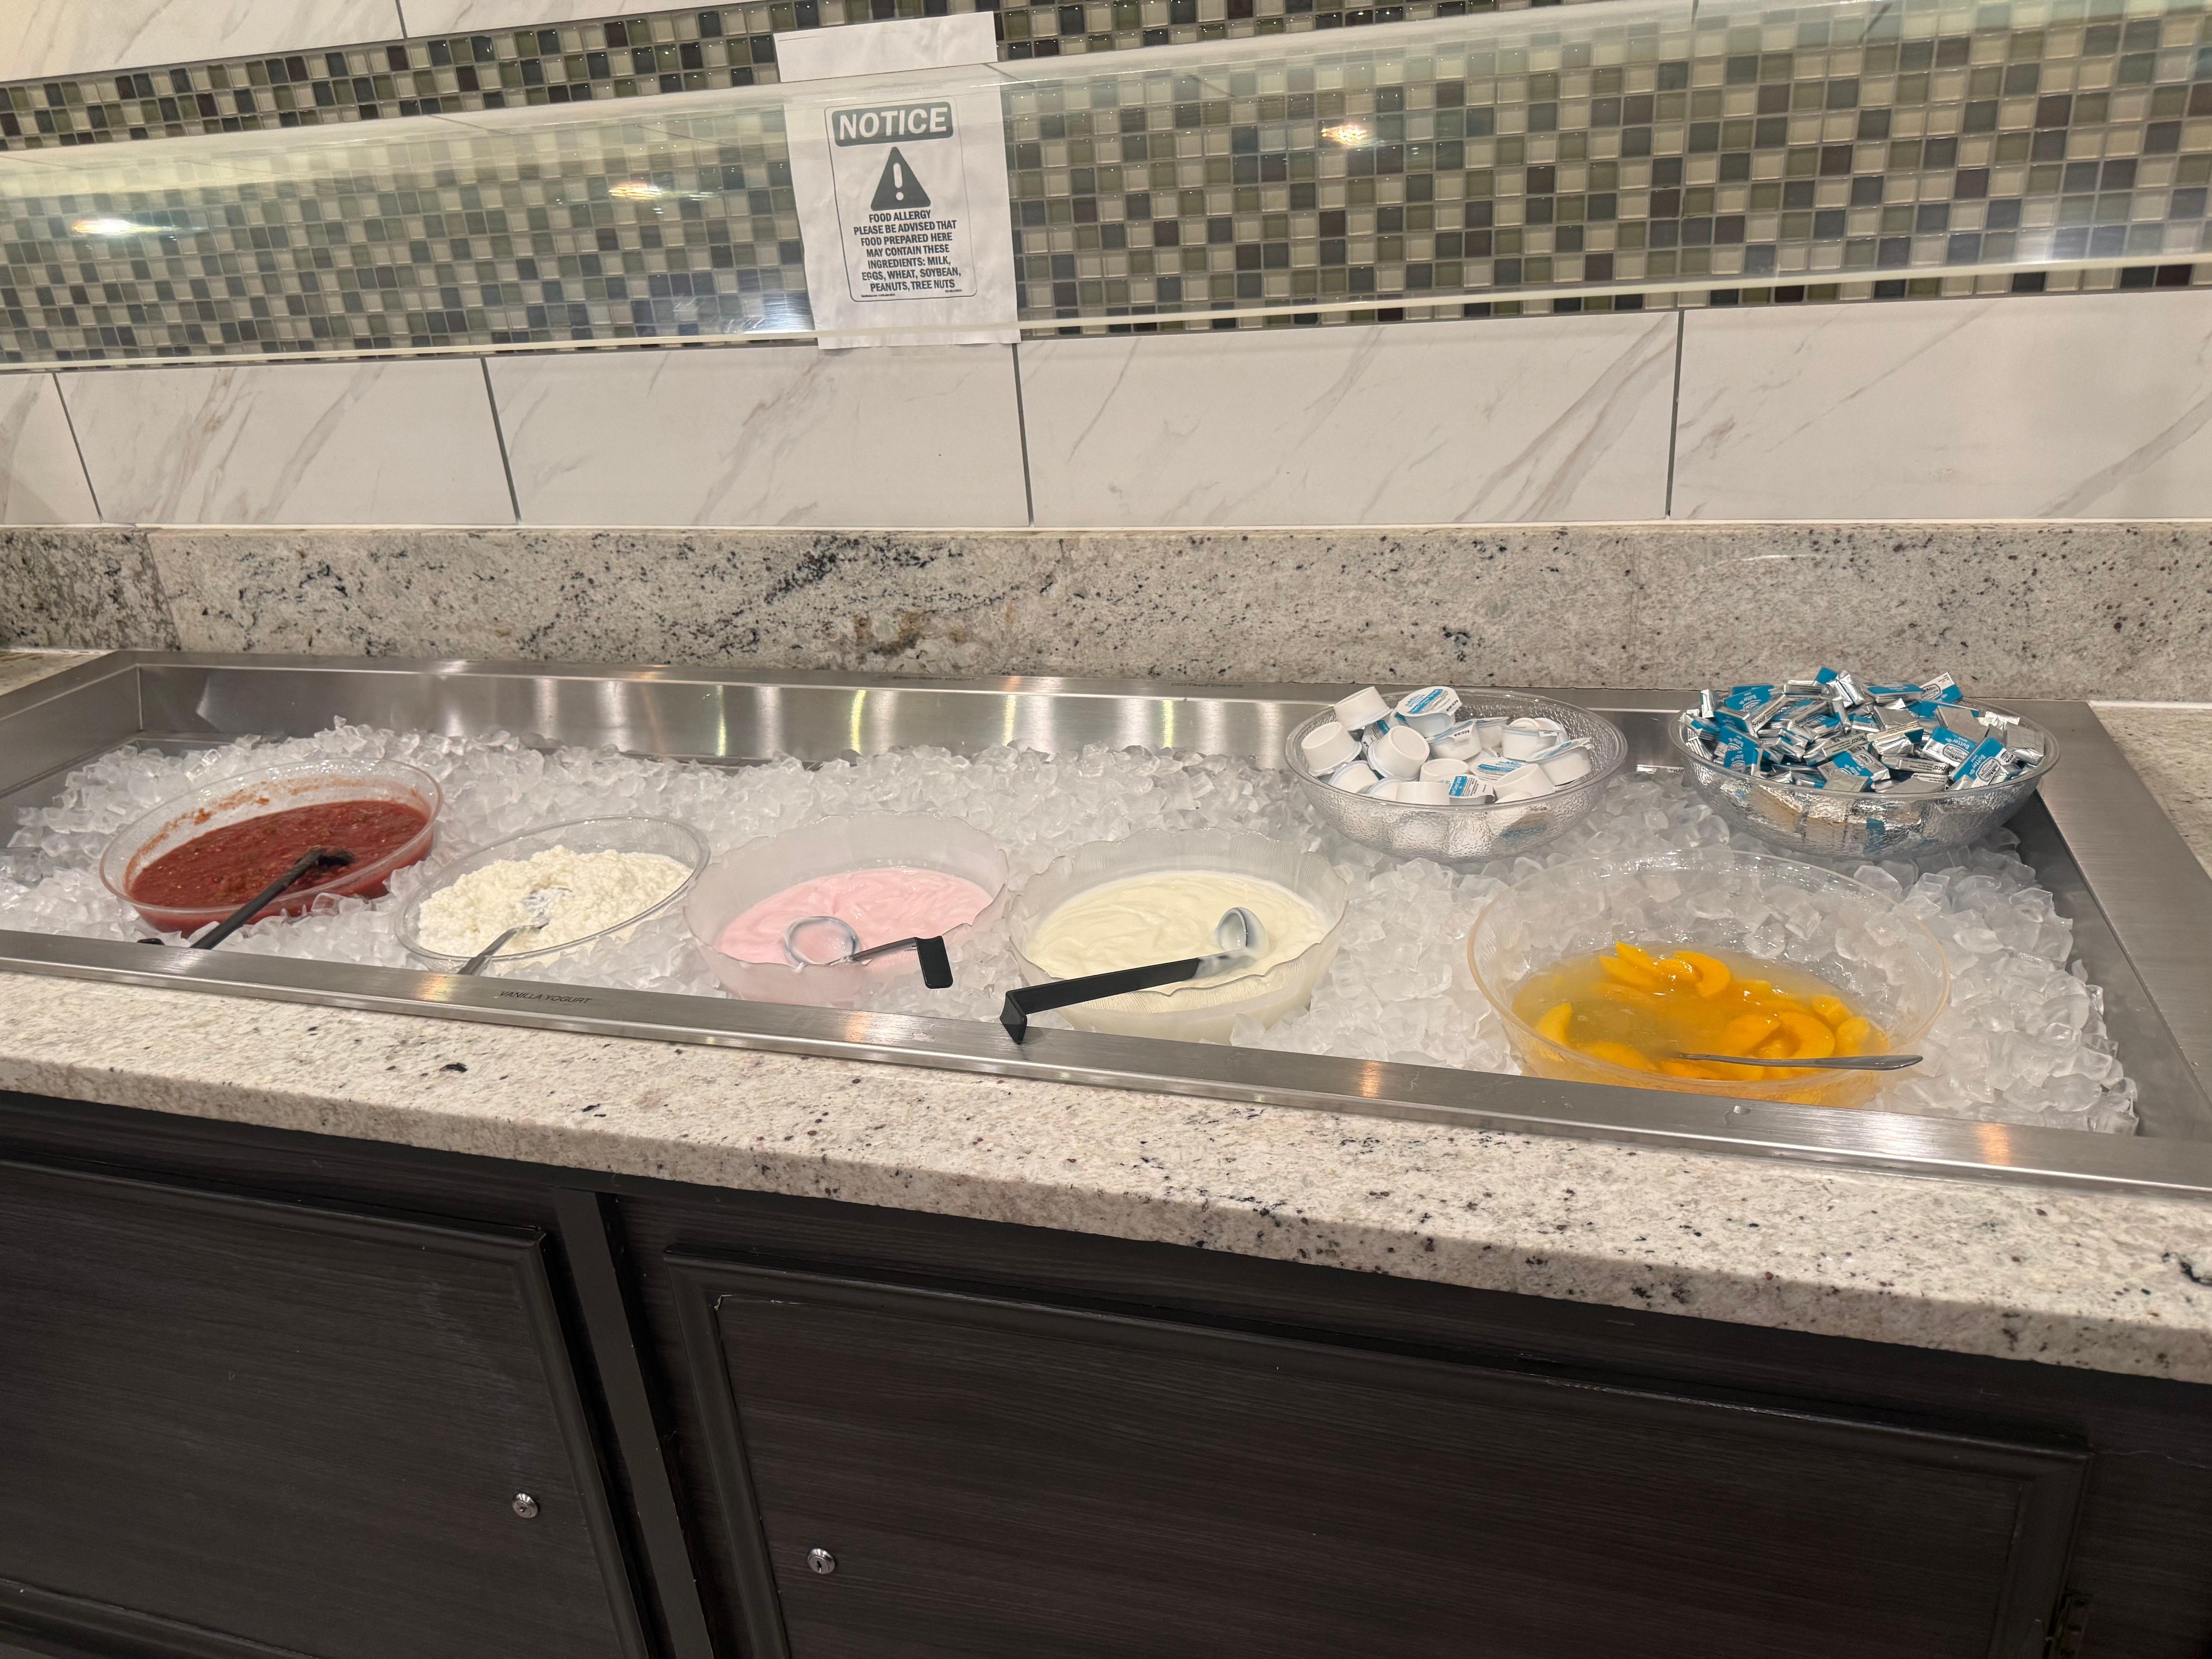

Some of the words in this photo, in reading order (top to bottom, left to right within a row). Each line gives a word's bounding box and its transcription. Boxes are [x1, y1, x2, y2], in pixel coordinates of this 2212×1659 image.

[840, 107, 948, 140] NOTICE
[869, 213, 891, 223] FOOD
[893, 210, 931, 221] ALLERGY
[854, 225, 883, 235] PLEASE
[885, 224, 897, 233] BE
[898, 221, 935, 233] ADVISED
[936, 220, 957, 230] THAT
[861, 237, 882, 246] FOOD
[883, 234, 929, 245] PREPARED
[930, 232, 952, 242] HERE
[866, 248, 883, 257] MAY
[885, 246, 922, 257] CONTAIN
[923, 244, 950, 254] THESE
[868, 257, 926, 269] INGREDIENTS:
[927, 256, 951, 266] MILK,
[862, 271, 886, 281] EGGS,
[887, 269, 918, 280] WHEAT,
[920, 267, 961, 278] SOYBEAN,
[870, 281, 910, 292] PEANUTS,
[910, 280, 932, 290] TREE
[933, 279, 955, 288] NUTS
[1752, 715, 1765, 728] Sysco
[1852, 735, 1866, 744] Sysco
[1952, 738, 1970, 749] Butter
[1972, 754, 1986, 769] Butter
[500, 991, 542, 999] VANILLA
[545, 995, 592, 1003] YOGURT
